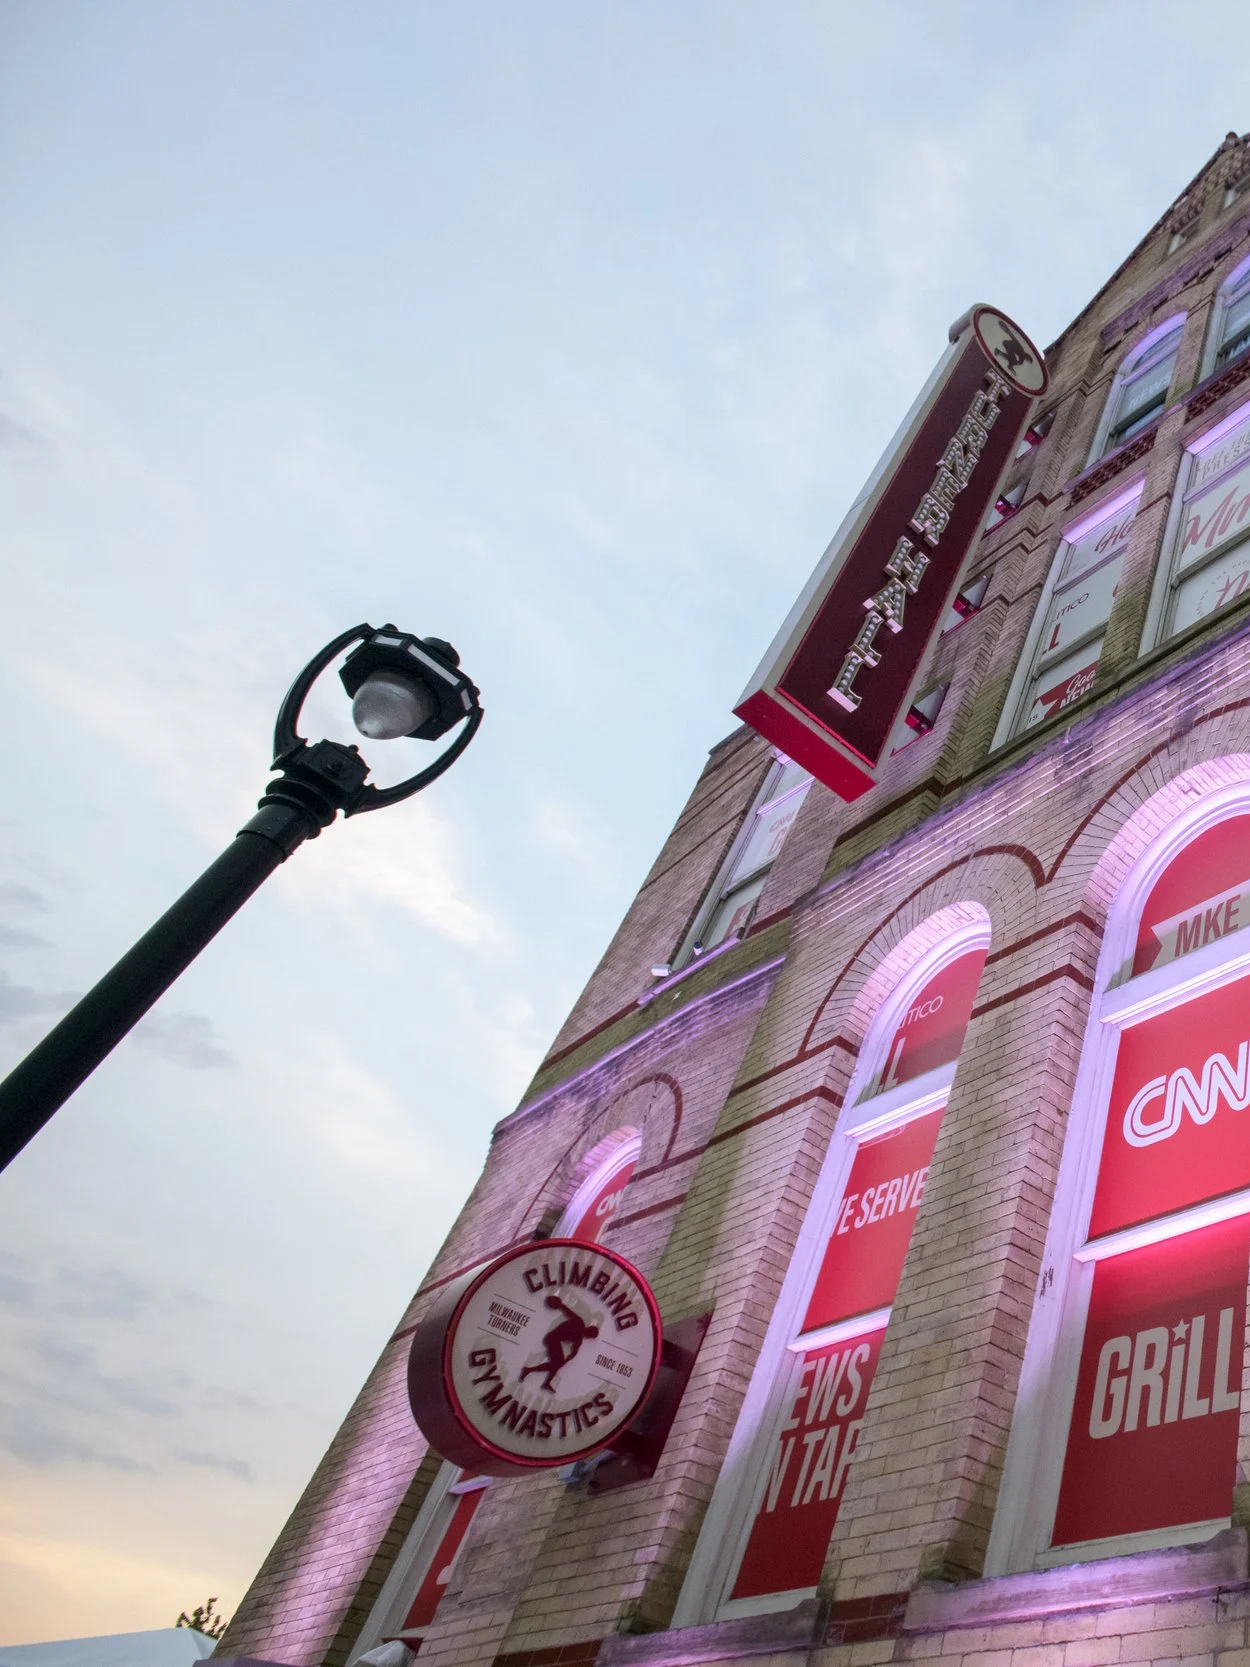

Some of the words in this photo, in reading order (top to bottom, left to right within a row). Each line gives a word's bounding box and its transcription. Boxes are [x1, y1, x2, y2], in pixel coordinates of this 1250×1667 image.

[908, 368, 1011, 548] TURNER
[826, 535, 931, 713] HALL
[1173, 893, 1242, 957] MKE
[853, 1165, 931, 1230] SERVE
[487, 1301, 532, 1328] MILWAUKEE
[487, 1313, 521, 1337] TURNERS
[522, 1260, 639, 1334] CLIMBING
[468, 1346, 614, 1440] GYMNASTICS
[595, 1353, 617, 1371] SINCE
